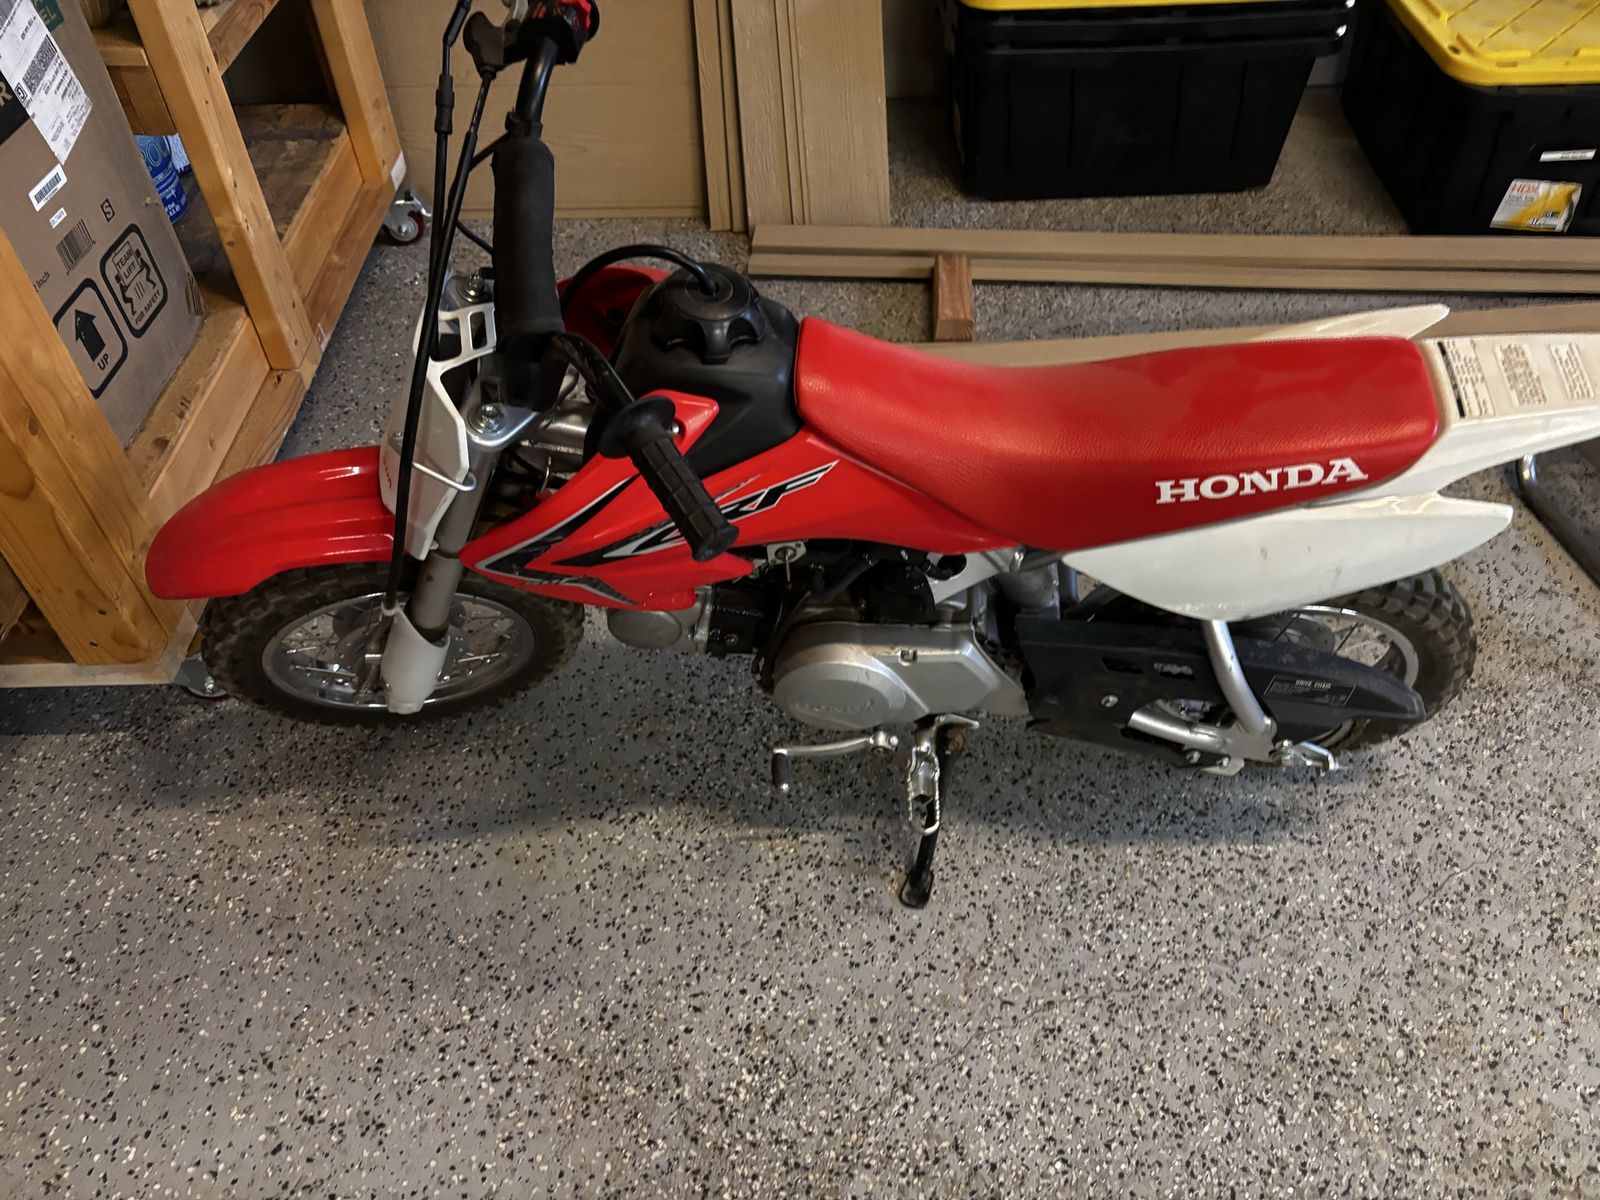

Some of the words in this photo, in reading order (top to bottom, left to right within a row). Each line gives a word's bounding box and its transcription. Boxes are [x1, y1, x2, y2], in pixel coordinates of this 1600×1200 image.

[116, 248, 133, 270] TEAM
[123, 262, 137, 280] LIFT
[135, 310, 145, 325] FOR
[144, 290, 161, 315] SAFETY
[97, 353, 110, 371] UP
[1155, 456, 1369, 505] HONDA
